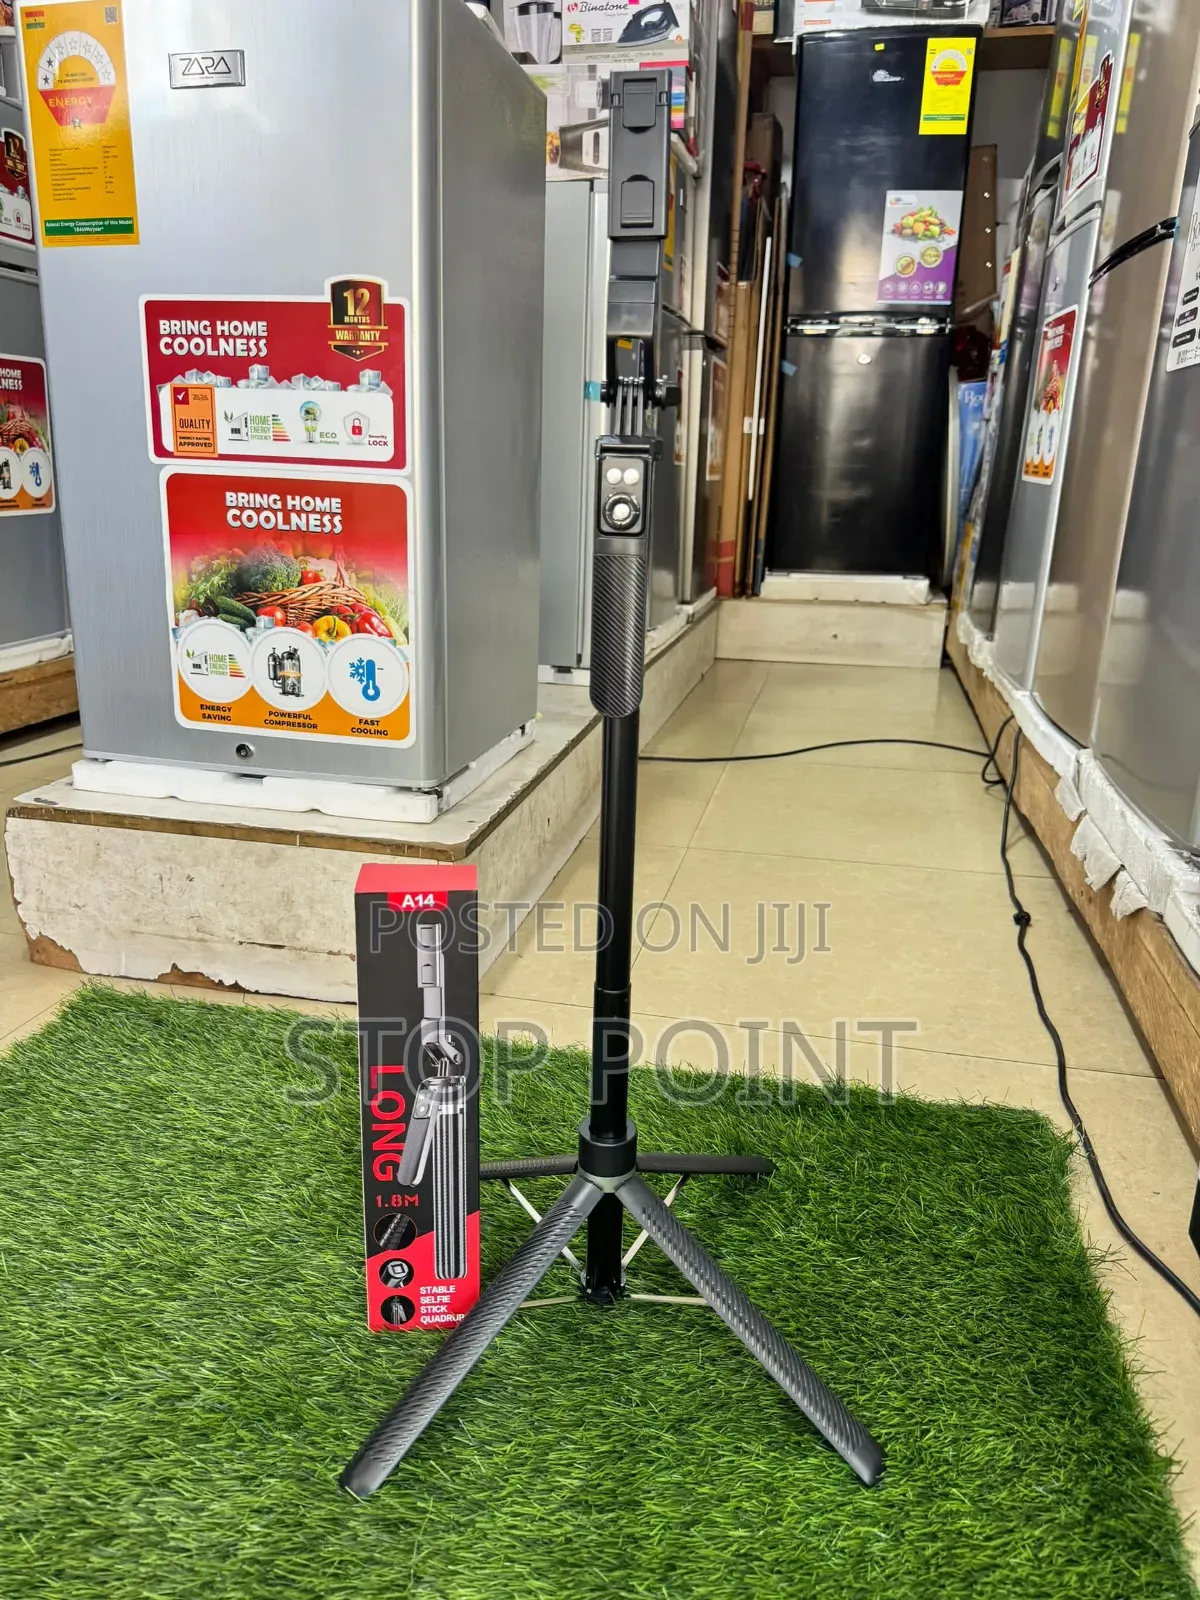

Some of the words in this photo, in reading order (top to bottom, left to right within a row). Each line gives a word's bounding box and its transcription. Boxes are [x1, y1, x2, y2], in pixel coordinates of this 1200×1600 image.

[579, 1, 629, 12] Binatone
[179, 56, 231, 76] ZARA
[48, 96, 93, 107] ENERGY
[343, 288, 370, 316] 12
[344, 315, 370, 323] MONTHS
[159, 320, 212, 335] BRING
[216, 320, 268, 336] HOME
[335, 330, 380, 341] WARRANTY
[159, 337, 268, 357] COOLNESS
[179, 418, 211, 429] QUALITY
[249, 415, 271, 426] HOME
[249, 426, 271, 434] ENERGY
[225, 491, 282, 509] BRING
[286, 495, 342, 513] HOME
[226, 508, 343, 535] COOLNESS
[208, 653, 228, 664] HOME
[200, 703, 232, 713] ENERGY
[201, 712, 232, 722] SAVING
[268, 710, 313, 720] POWERFUL
[264, 718, 318, 729] COMPRESSOR
[358, 718, 380, 727] FAST
[351, 726, 389, 736] COOLING
[402, 893, 435, 909] A14
[370, 1065, 406, 1182] LONG
[375, 1193, 419, 1209] 1.8M
[420, 1284, 457, 1295] STABLE
[420, 1295, 451, 1304] SELFIE
[420, 1304, 448, 1314] STICK
[420, 1313, 465, 1325] QUADRUP
